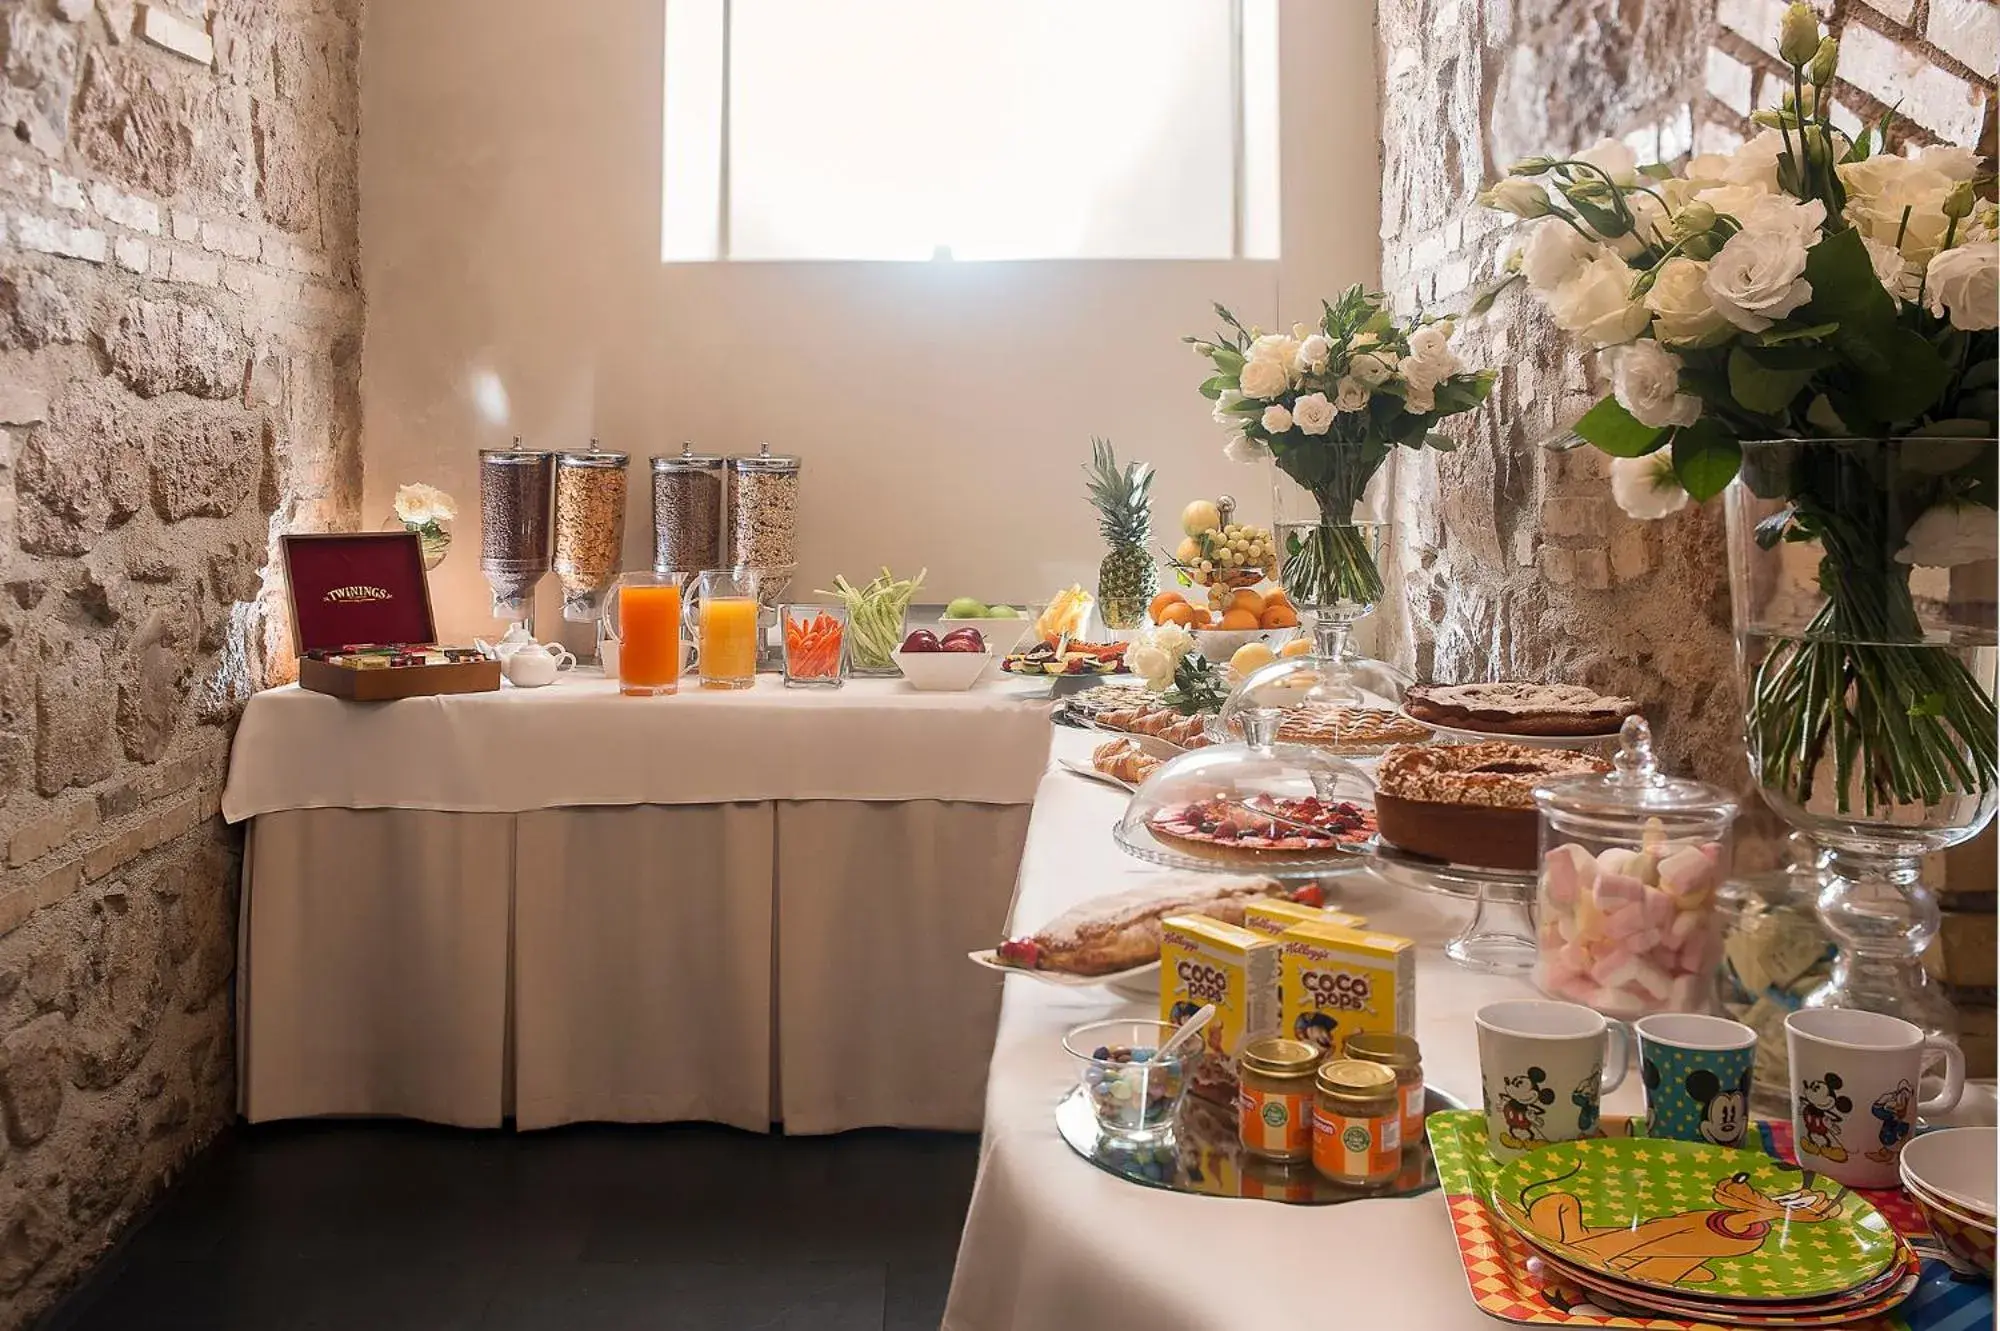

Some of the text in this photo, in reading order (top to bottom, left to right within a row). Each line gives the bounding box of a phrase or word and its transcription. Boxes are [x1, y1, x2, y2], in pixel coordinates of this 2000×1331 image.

[327, 586, 388, 601] TWININGS
[1188, 982, 1223, 1003] pops
[1315, 992, 1362, 1010] pops
